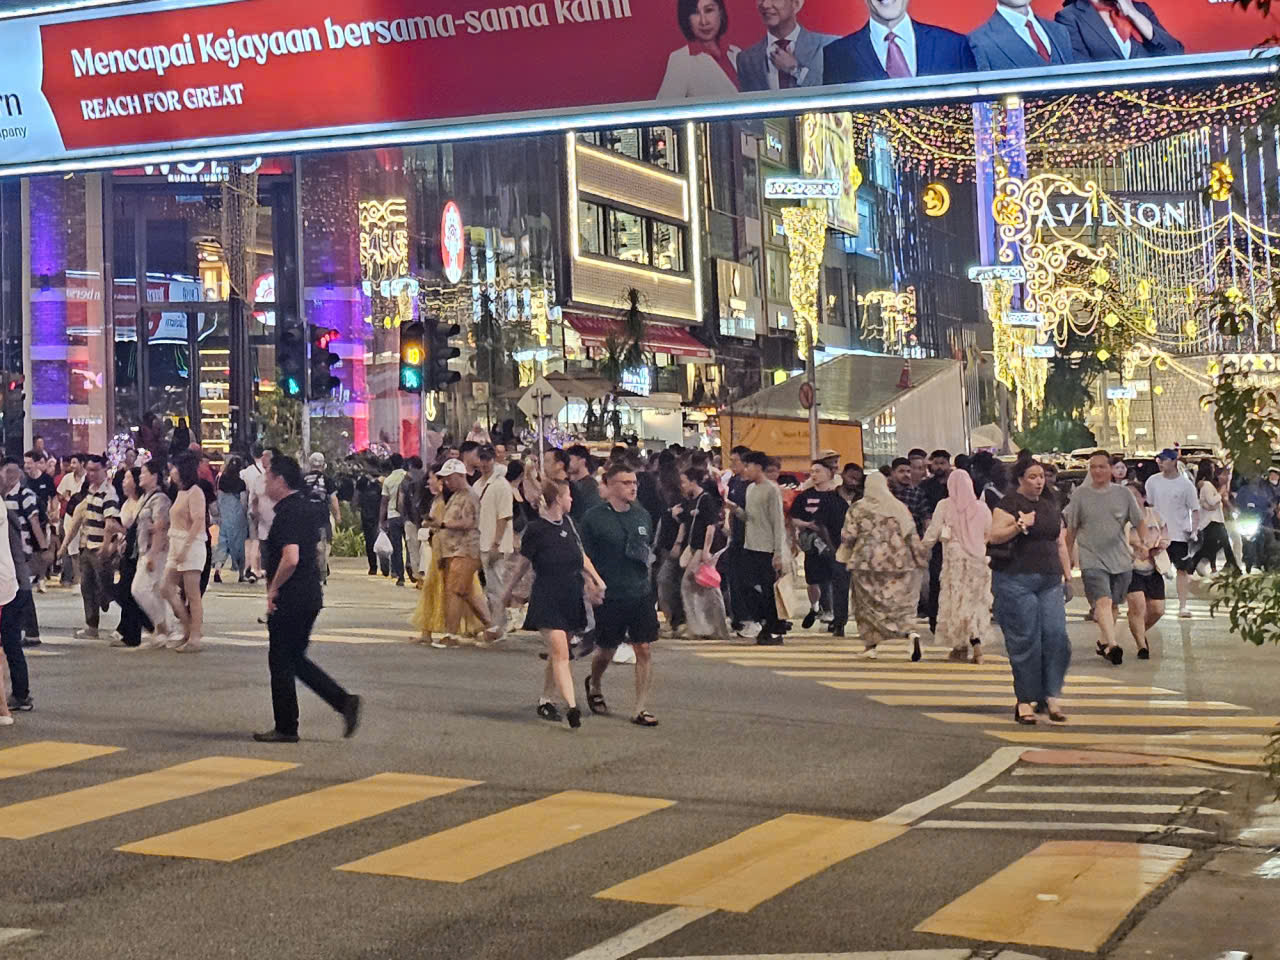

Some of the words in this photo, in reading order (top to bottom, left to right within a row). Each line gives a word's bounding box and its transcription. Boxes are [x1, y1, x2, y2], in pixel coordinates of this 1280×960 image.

[71, 33, 195, 78] Mencapai
[196, 27, 322, 69] Kejayaan
[324, 2, 549, 50] bersama-sama
[80, 95, 142, 121] REACH
[143, 90, 182, 113] FOR
[183, 82, 244, 109] GREAT
[199, 173, 231, 182] LUMPU
[1036, 201, 1186, 228] AVILION
